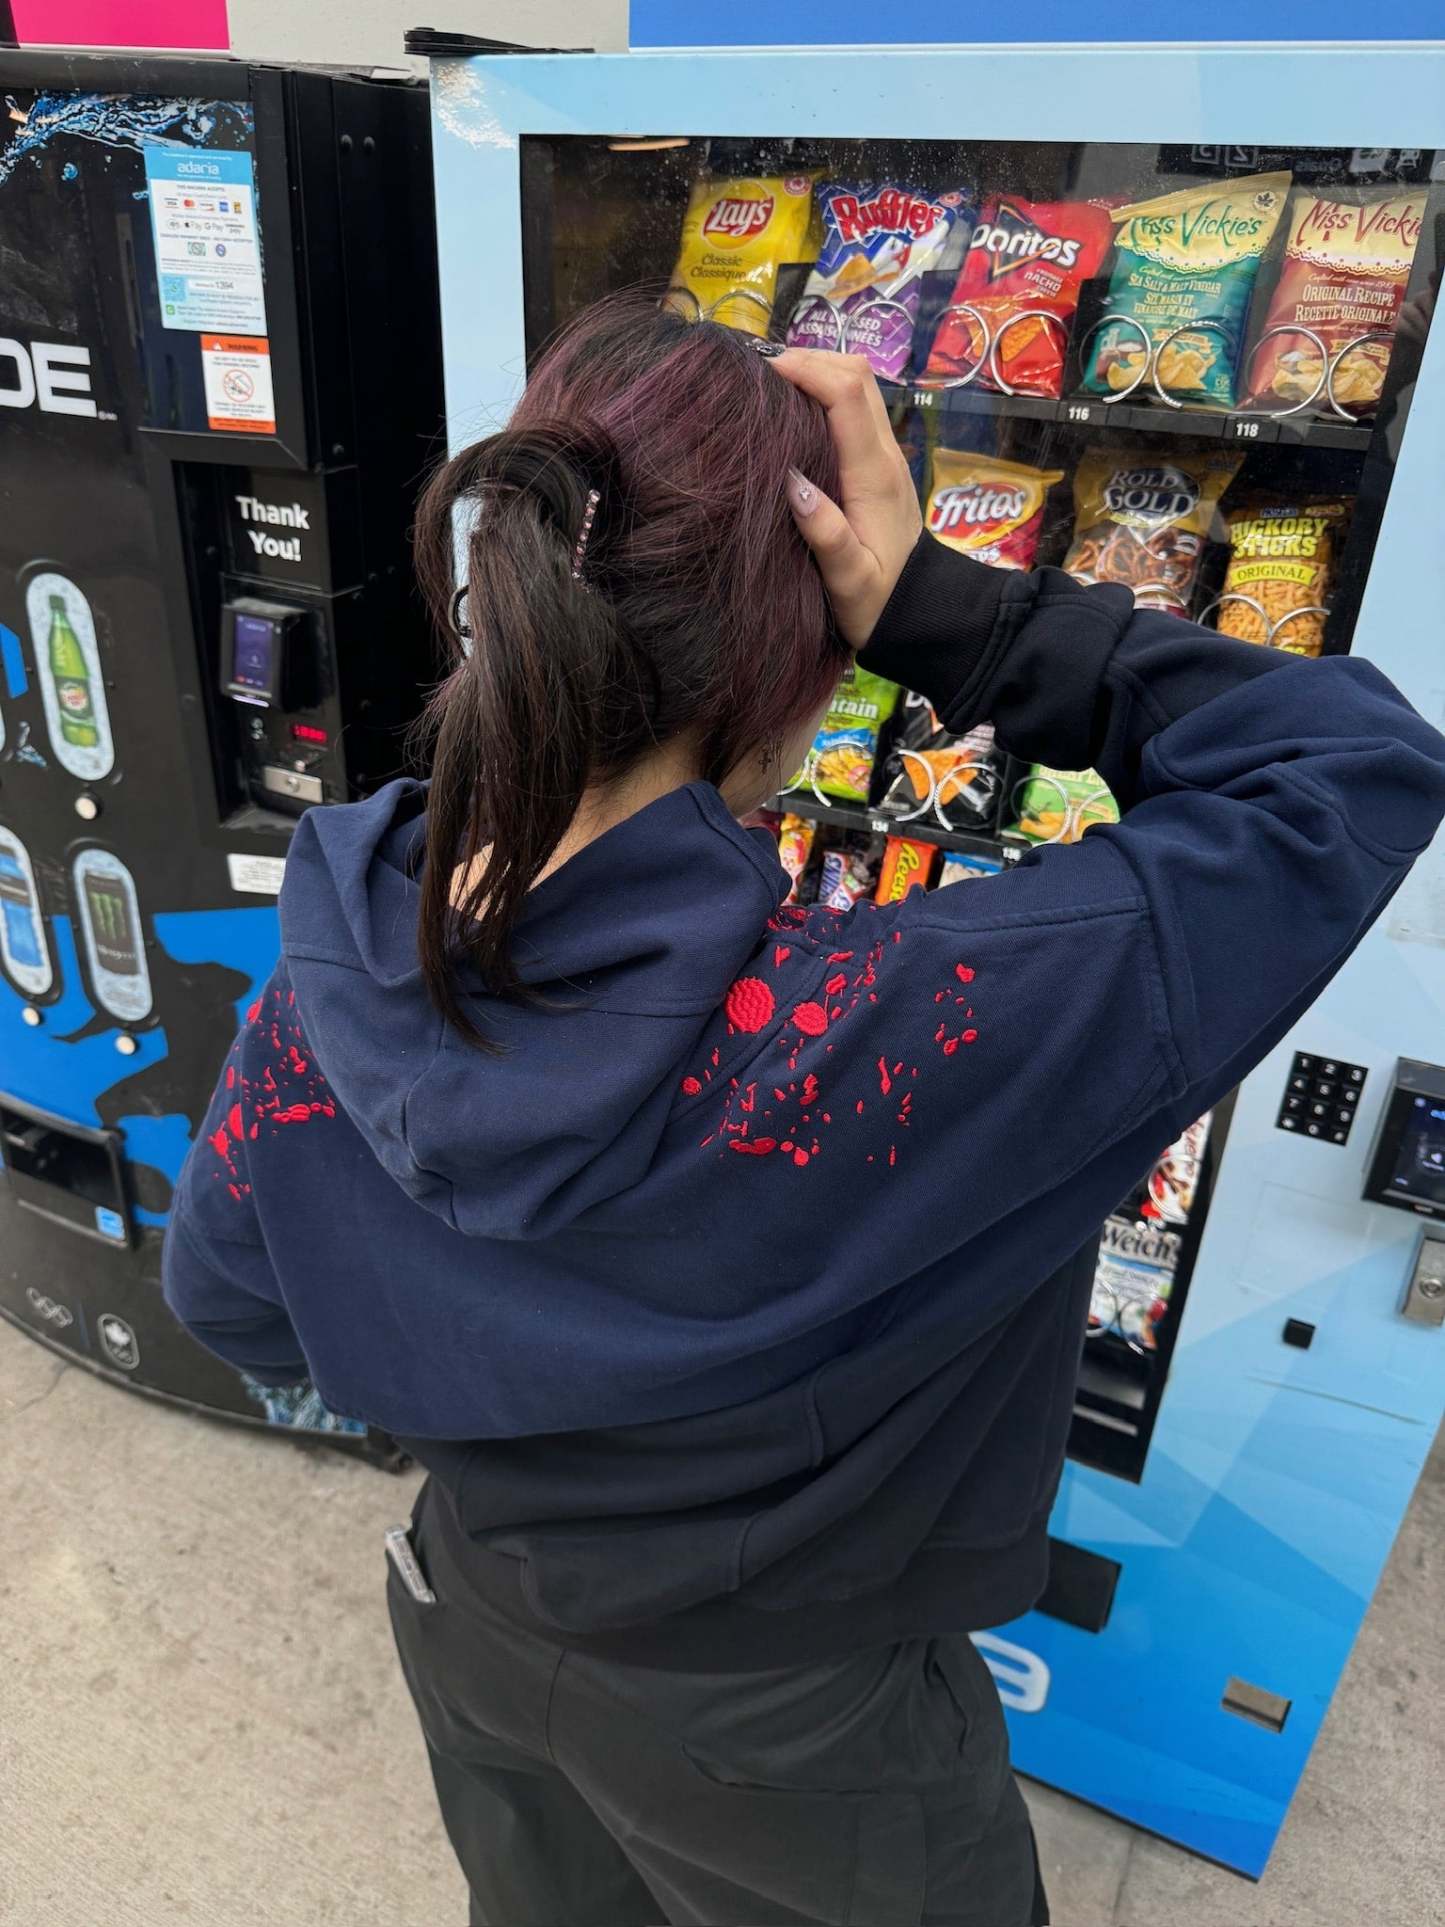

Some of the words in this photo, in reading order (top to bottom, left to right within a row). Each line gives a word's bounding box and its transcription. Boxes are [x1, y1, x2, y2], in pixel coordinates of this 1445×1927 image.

[177, 160, 219, 175] adaria
[705, 197, 768, 238] Lay's
[829, 188, 944, 244] Ruffles
[1179, 200, 1264, 249] Vickie's
[970, 223, 1081, 267] Doritos
[702, 254, 743, 266] Classic
[1302, 284, 1354, 302] ORIGINAL
[1353, 286, 1396, 308] RECIPE
[1294, 304, 1341, 322] RECETTE
[1341, 305, 1397, 325] ORIGINALE
[913, 393, 933, 406] 114
[1068, 406, 1090, 421] 116
[1236, 422, 1260, 438] 118
[1108, 468, 1181, 489] ROLD
[235, 495, 310, 530] Thank
[930, 478, 1030, 531] Fritos
[1101, 485, 1196, 518] GOLD
[1230, 518, 1330, 545] HICKORY
[248, 530, 302, 562] You!
[1234, 534, 1319, 559] STICKS
[1237, 565, 1308, 582] ORIGINAL
[1325, 1063, 1336, 1075] 2
[1351, 1069, 1363, 1082] 3
